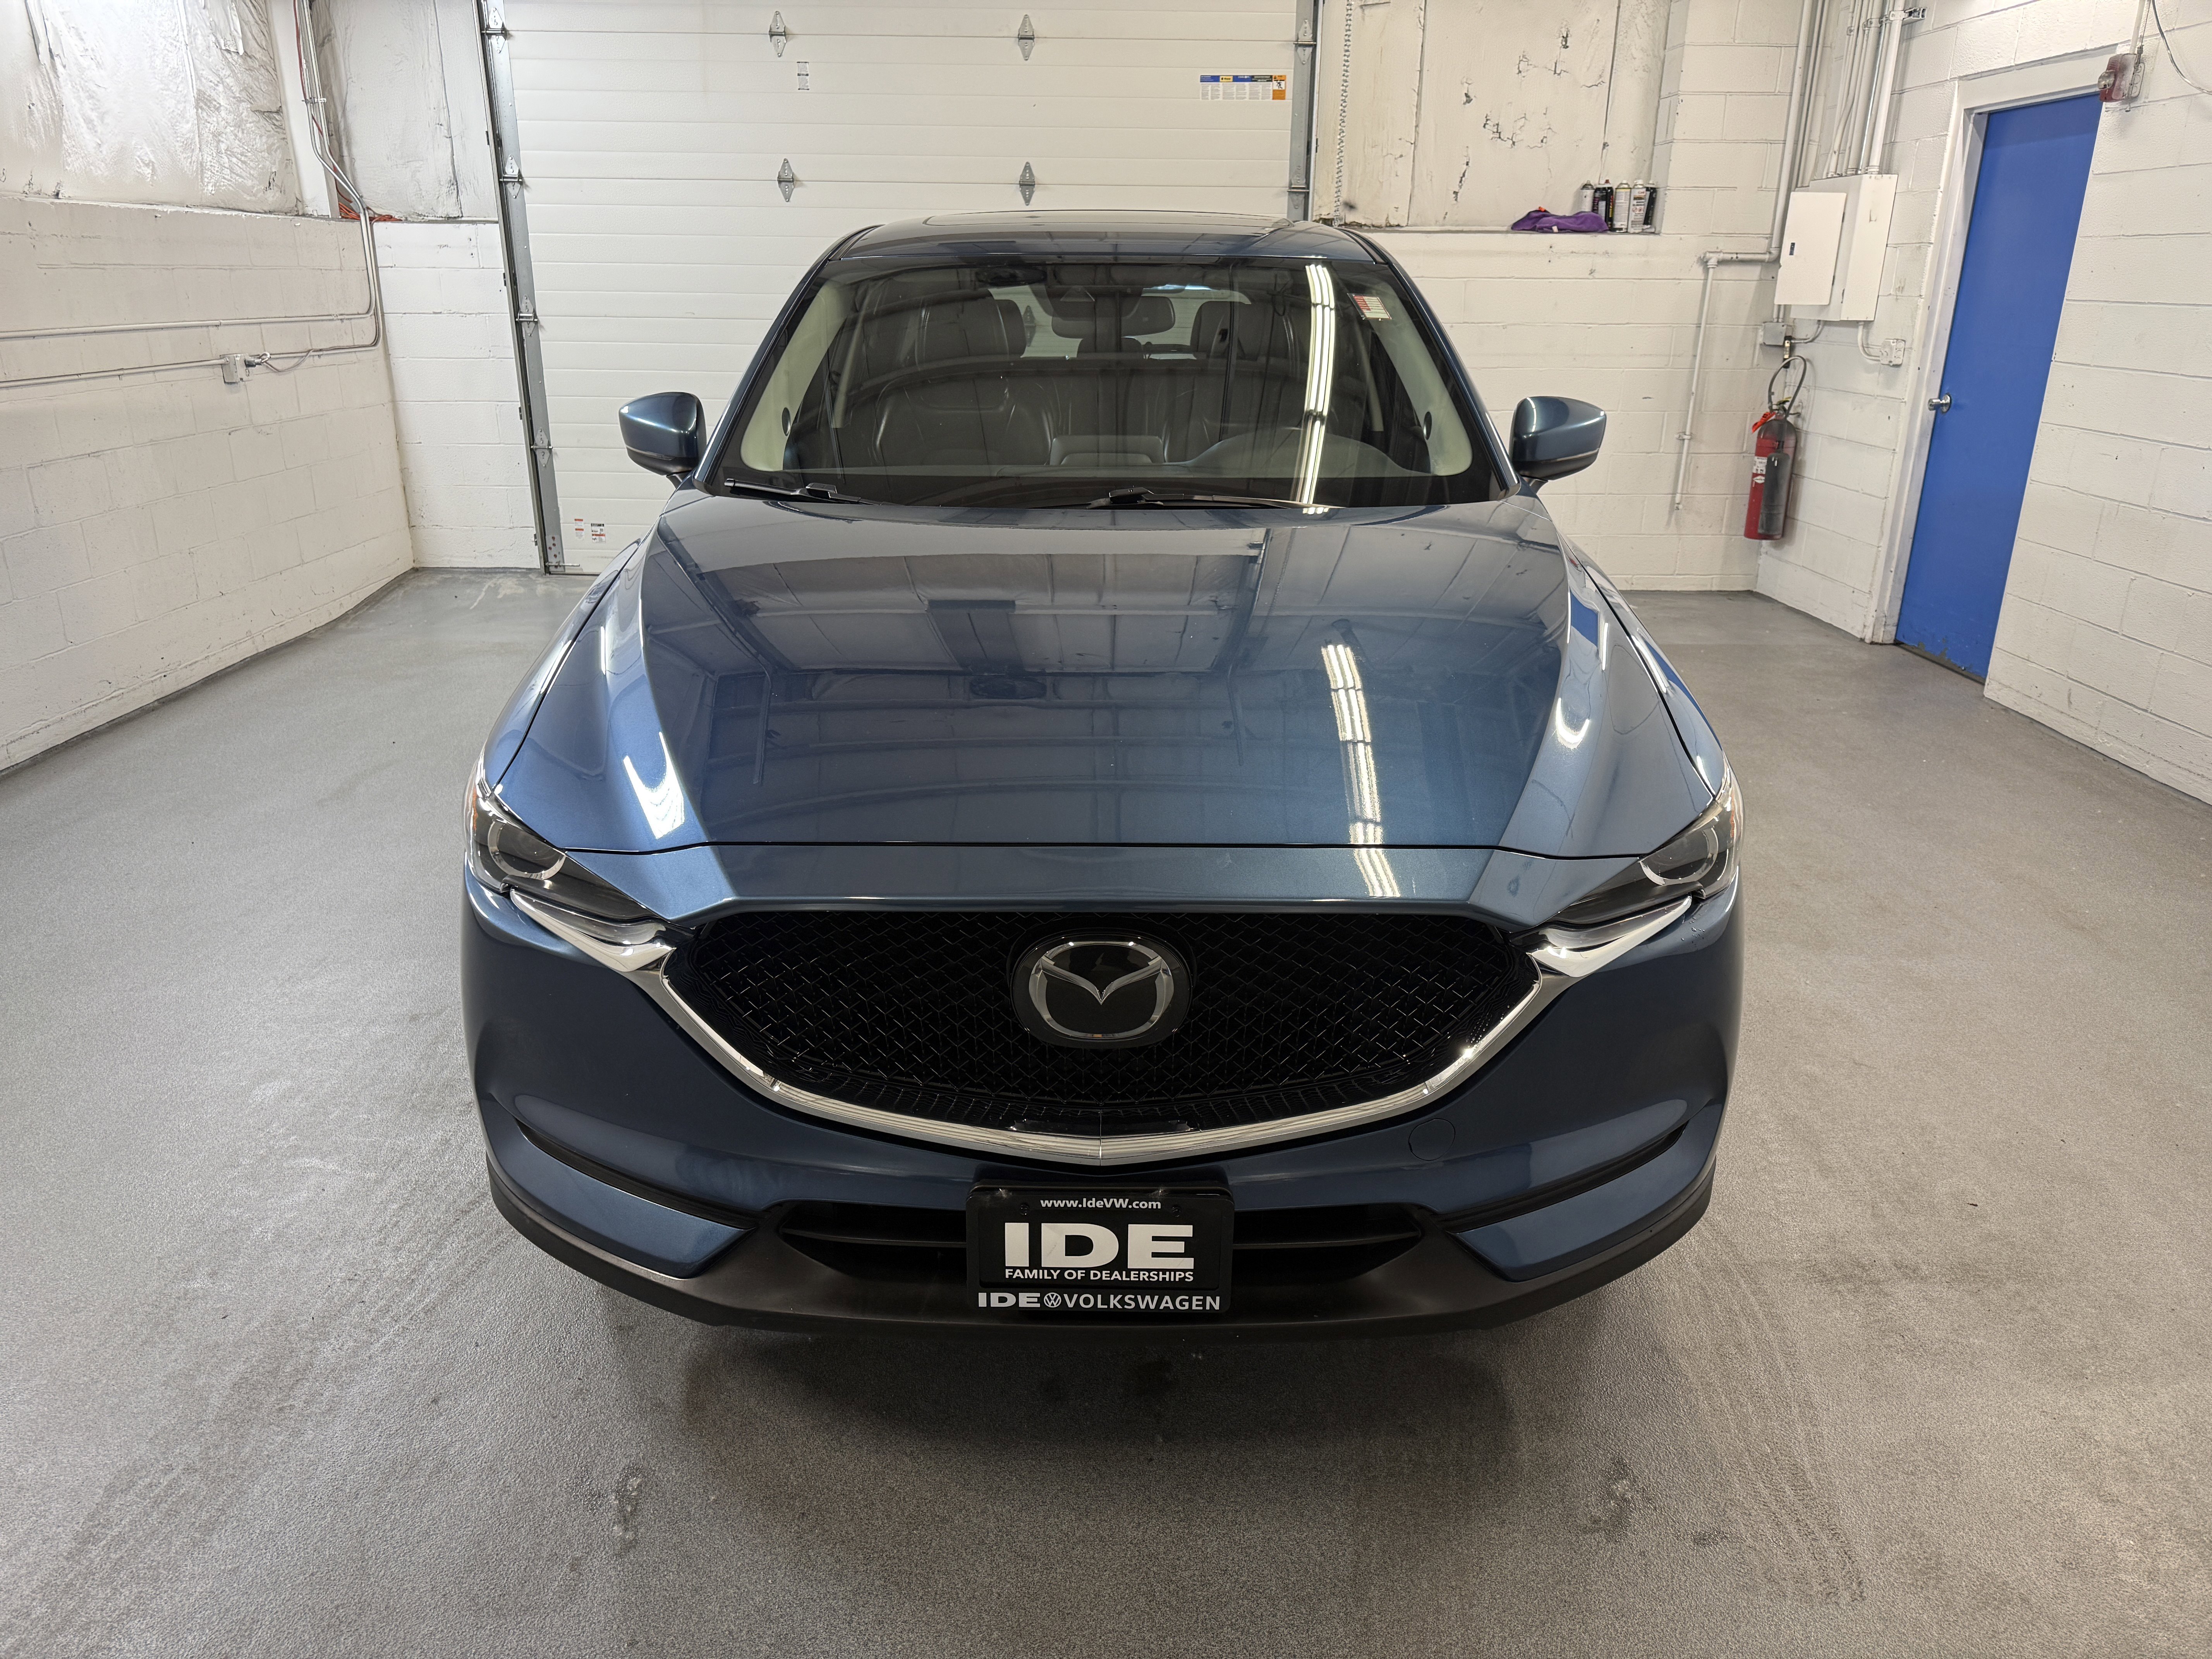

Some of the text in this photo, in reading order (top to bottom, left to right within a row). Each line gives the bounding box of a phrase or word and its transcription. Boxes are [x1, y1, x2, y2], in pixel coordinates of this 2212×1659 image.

[1040, 1198, 1161, 1209] www.IdeVW.com
[1005, 1222, 1194, 1269] IDE
[1005, 1269, 1194, 1282] FAMILY OF DEALERSHIPS
[978, 1292, 1041, 1307] IDE
[1063, 1294, 1220, 1310] VOLKSWAGEN
